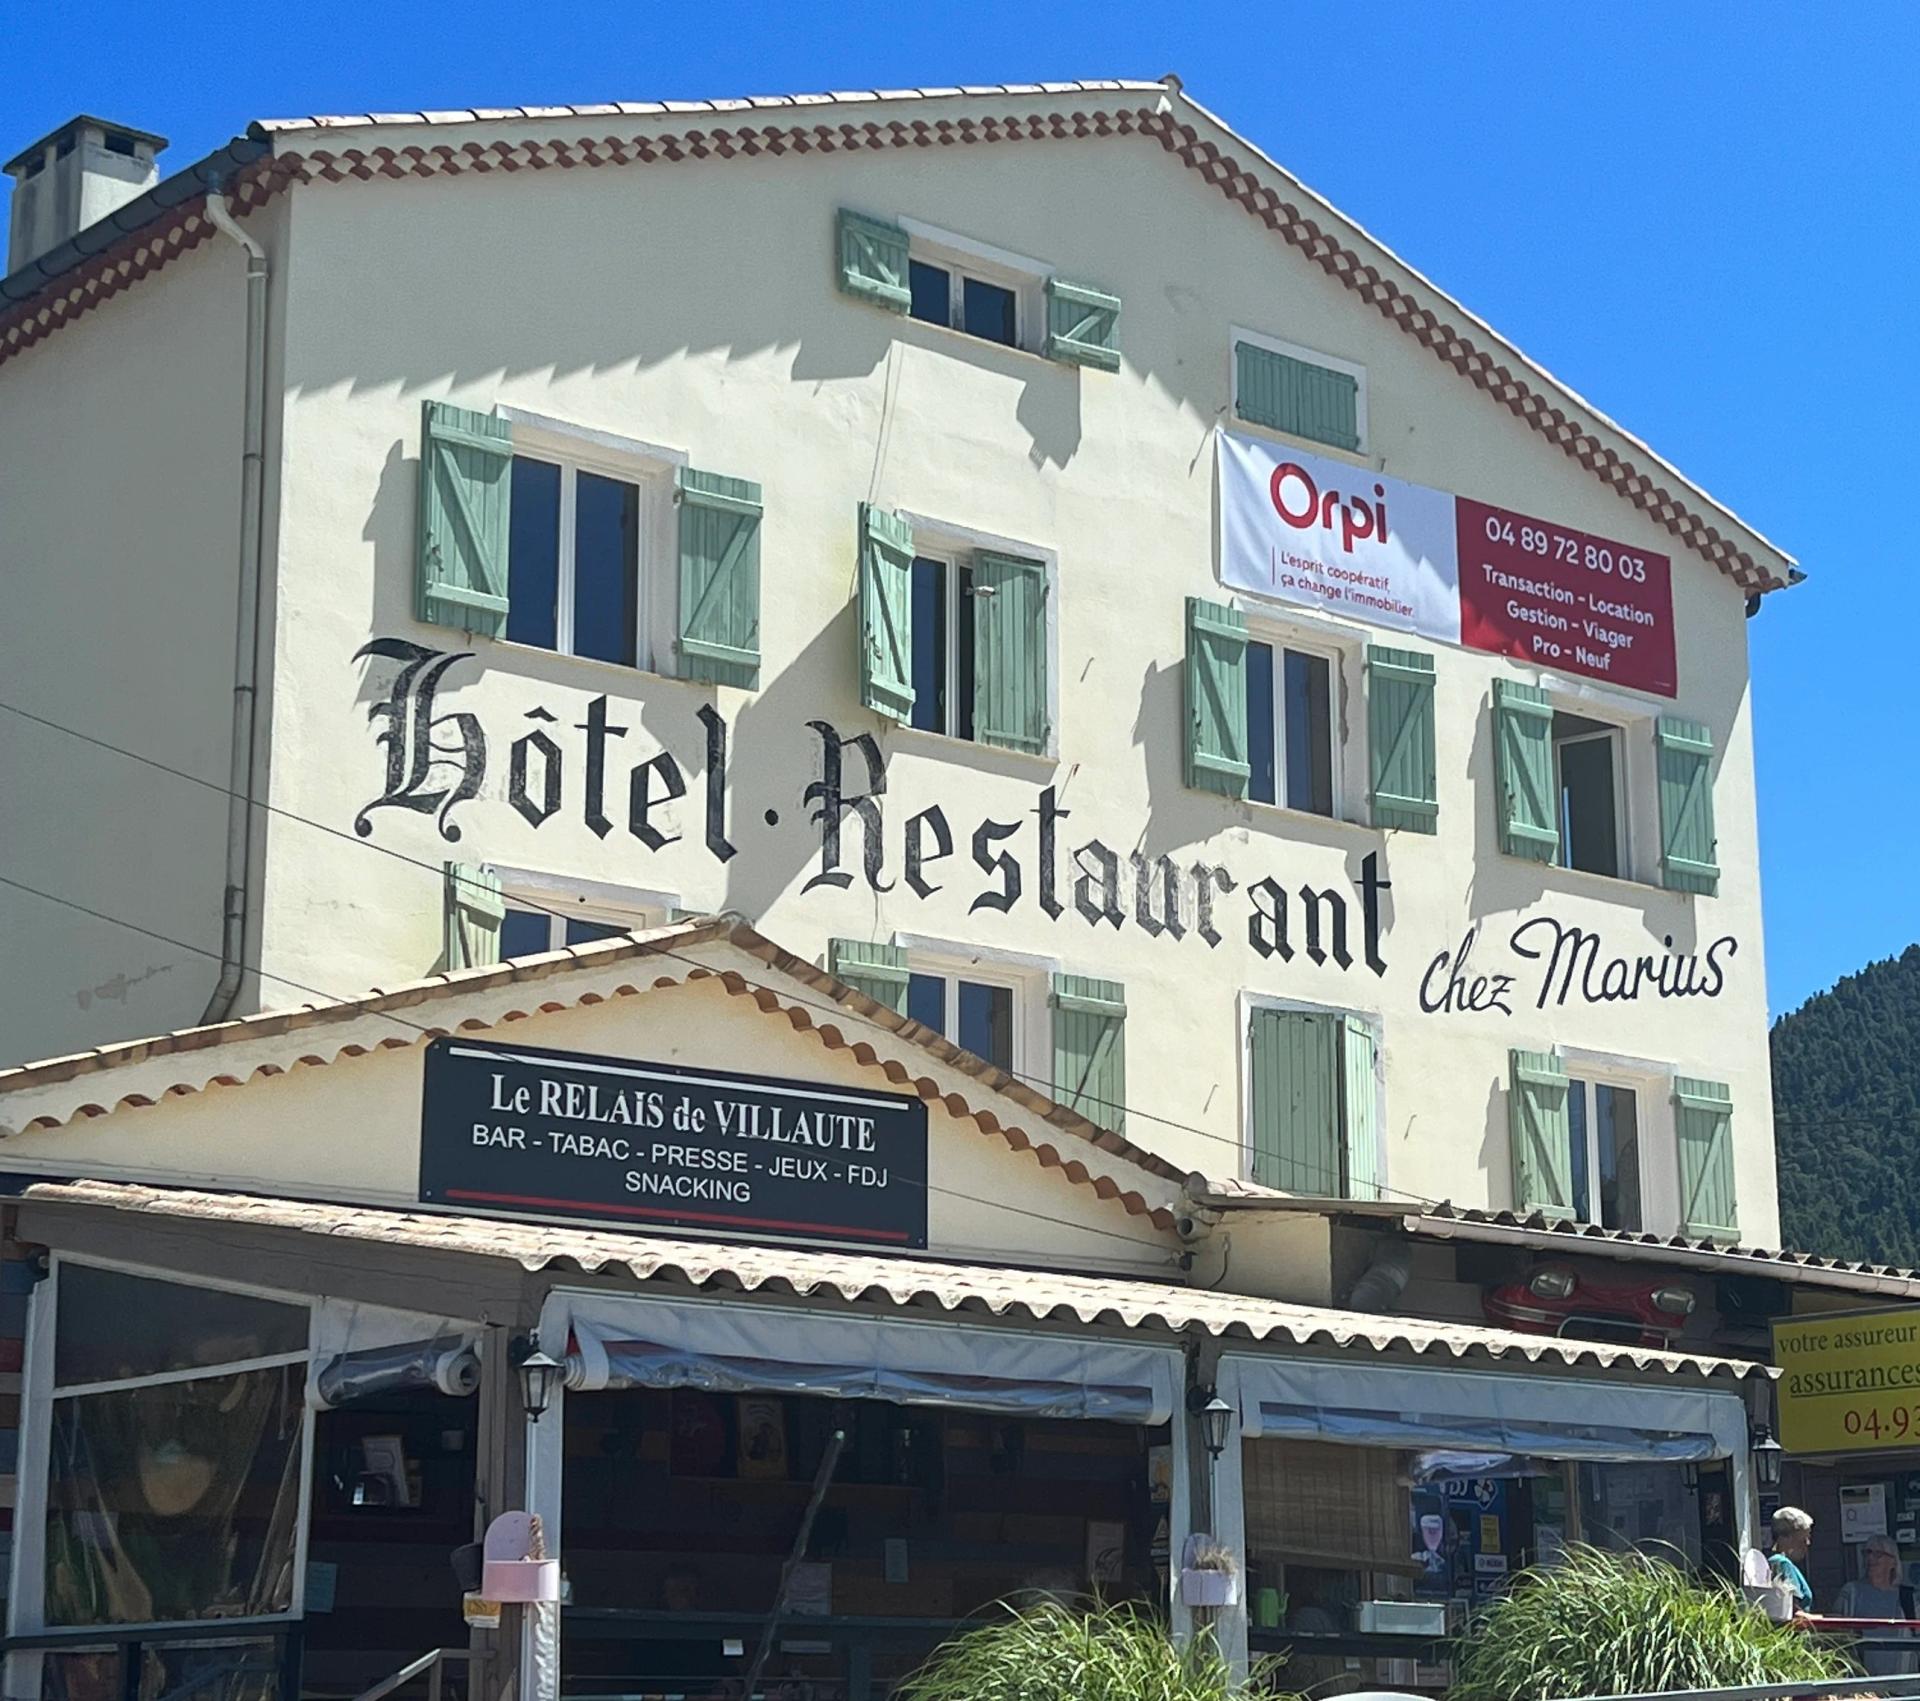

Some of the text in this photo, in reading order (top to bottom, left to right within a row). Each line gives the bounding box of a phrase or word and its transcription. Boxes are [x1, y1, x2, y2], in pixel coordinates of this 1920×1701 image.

[1270, 462, 1387, 553] Orpi
[1281, 550, 1391, 593] L'esprit coopératif,
[1485, 517, 1647, 583] 04 89 72 80 03
[1281, 573, 1415, 617] ça change l'immobilier.
[1482, 563, 1574, 606] Transaction
[1589, 592, 1655, 627] Location
[1506, 599, 1568, 632] Gestion
[1583, 618, 1634, 650] Viager
[1532, 635, 1560, 658] Pro
[1575, 645, 1611, 671] Neuf
[352, 637, 738, 864] Hôtel
[800, 720, 1392, 978] Restaurant
[1419, 916, 1738, 1016] Chez Marius
[491, 1073, 876, 1152] Le RELAIS de VILLAUTE
[472, 1124, 527, 1150] BAR
[548, 1132, 630, 1161] TABAC
[651, 1143, 748, 1173] PRESSE
[768, 1157, 828, 1182] JEUX
[848, 1164, 888, 1188] FDJ
[625, 1170, 751, 1203] SNACKING
[1778, 1325, 1917, 1353] votre assureur
